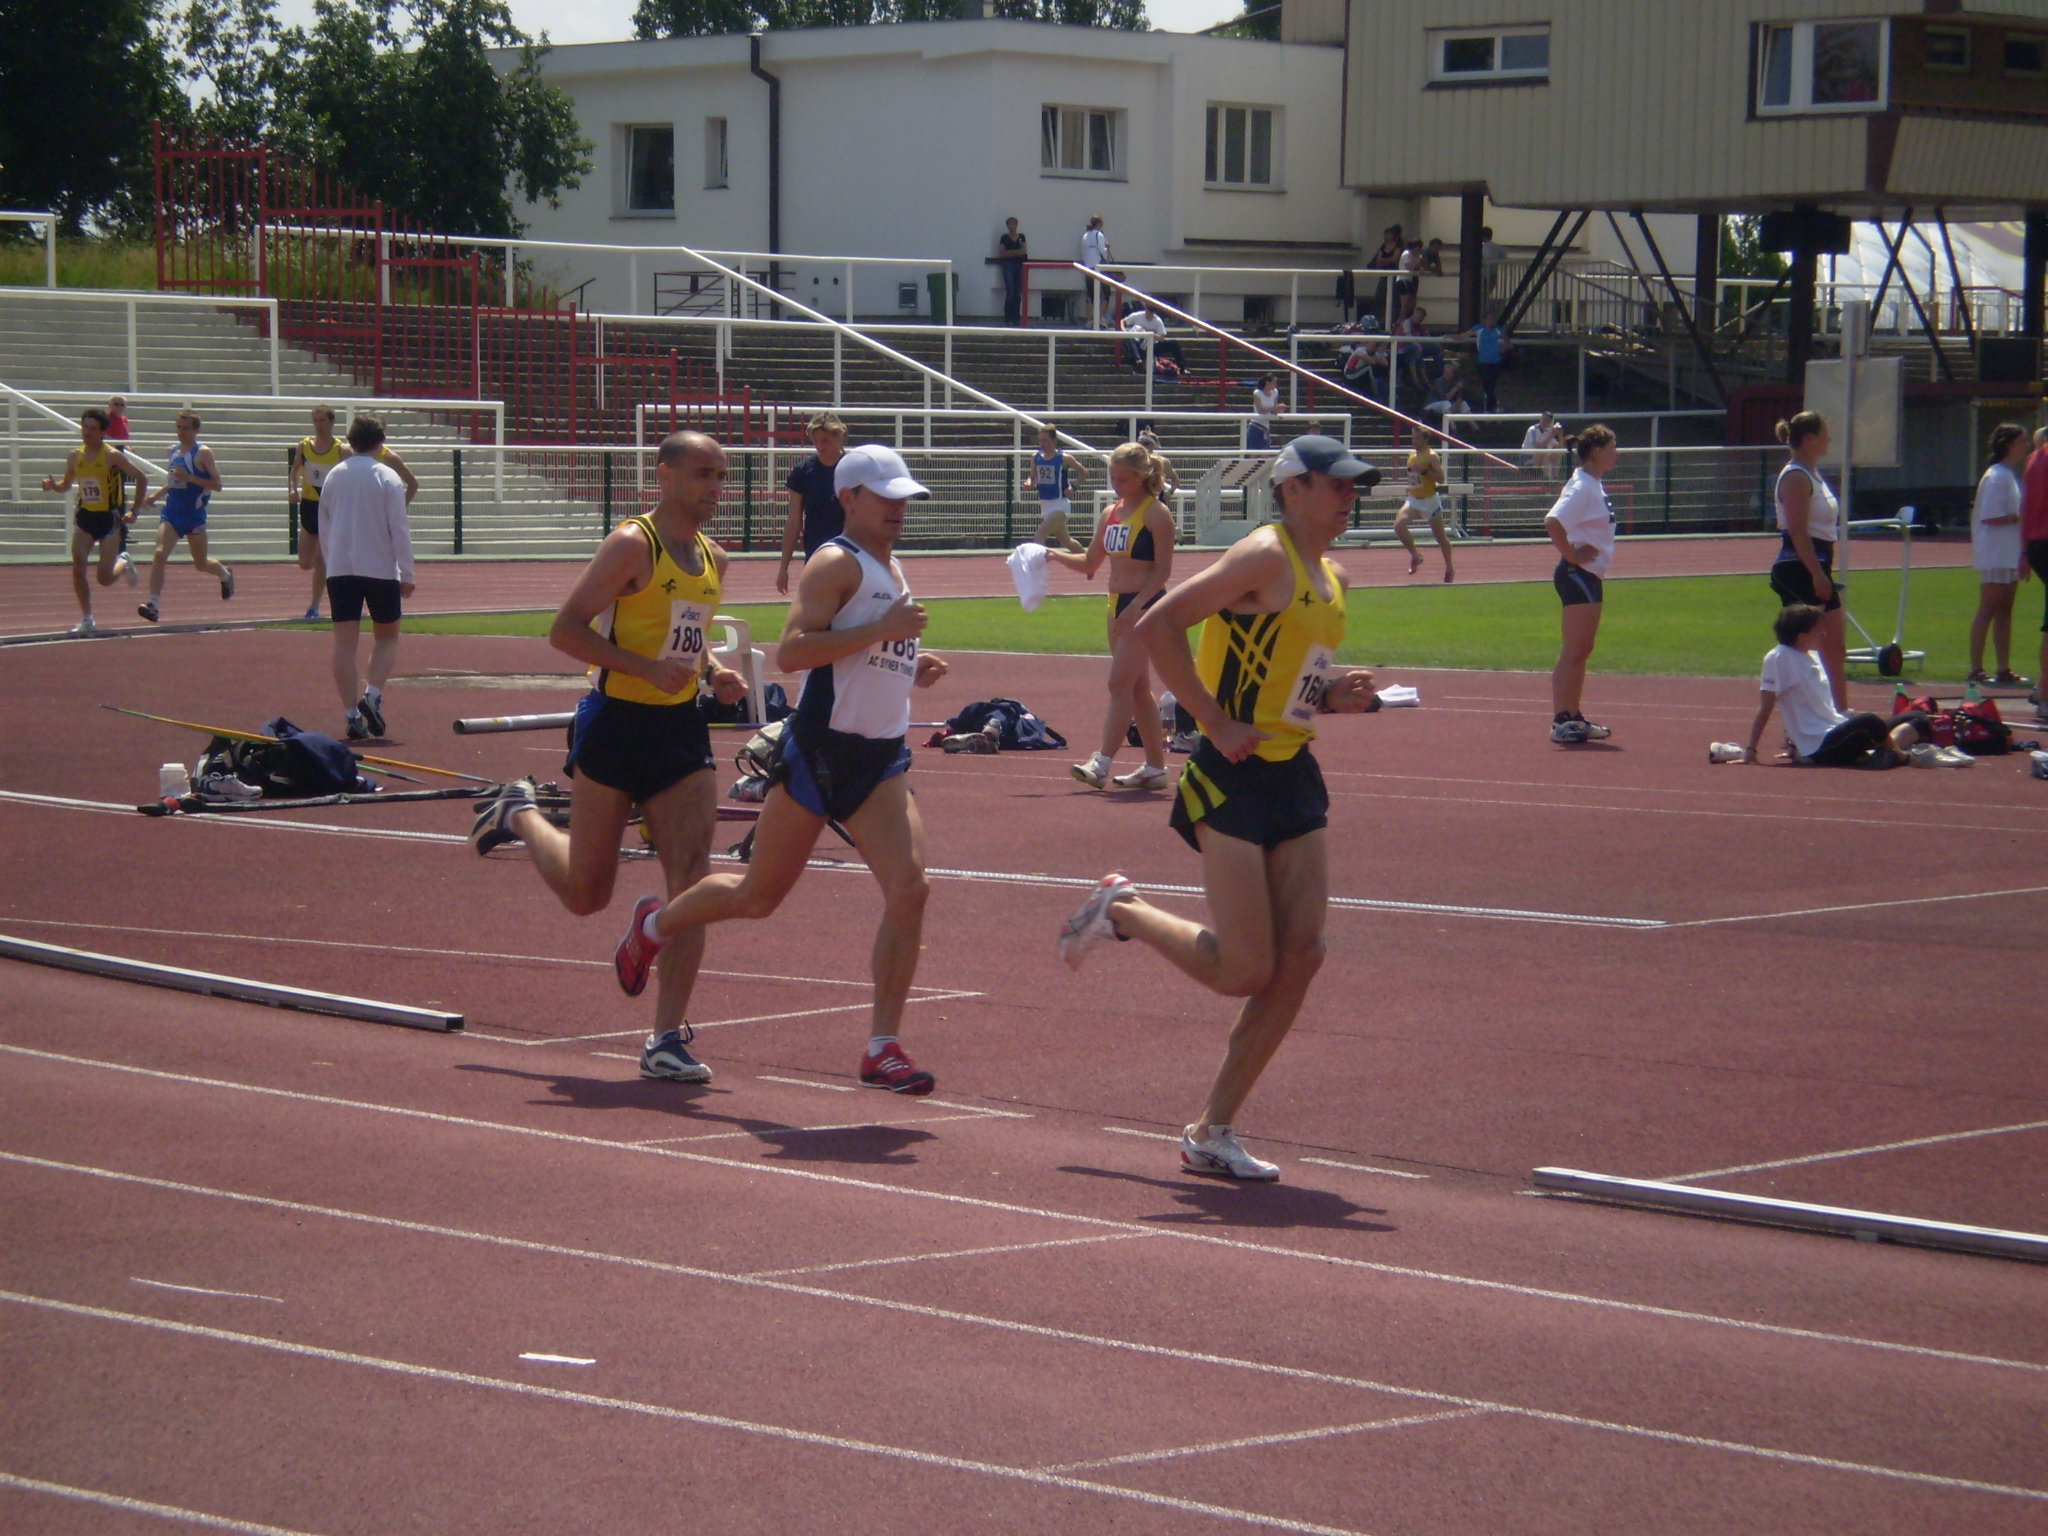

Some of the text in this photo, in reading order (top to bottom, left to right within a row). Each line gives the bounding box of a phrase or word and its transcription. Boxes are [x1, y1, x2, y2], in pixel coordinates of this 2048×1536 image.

[1040, 467, 1051, 479] 92
[83, 487, 100, 496] 179
[1106, 526, 1128, 552] 105
[672, 626, 703, 653] 180
[1298, 674, 1324, 706] 16
